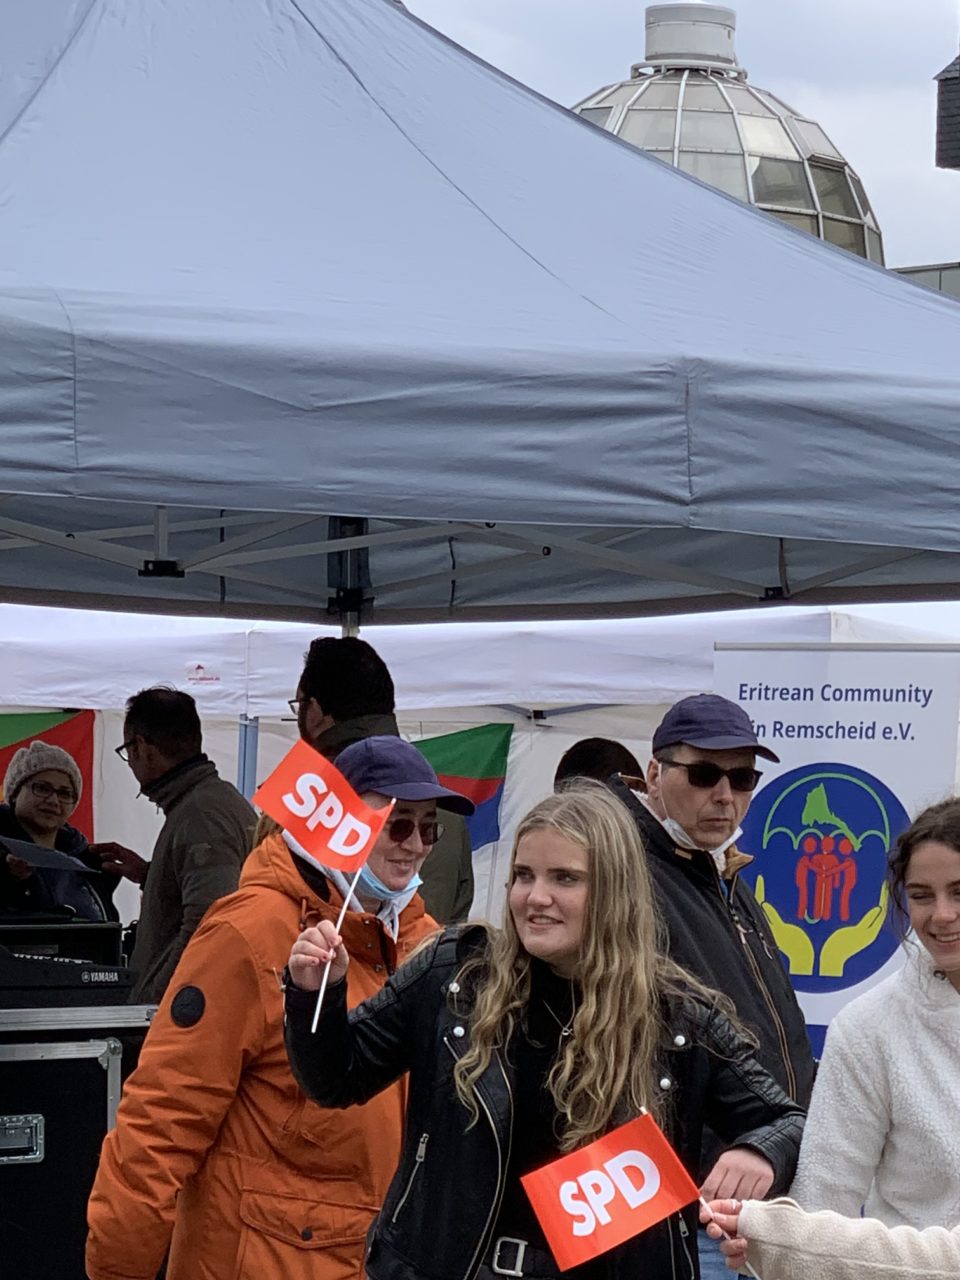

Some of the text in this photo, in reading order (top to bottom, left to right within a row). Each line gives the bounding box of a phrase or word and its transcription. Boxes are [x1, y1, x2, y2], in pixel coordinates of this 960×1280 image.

[738, 683, 933, 708] Eritrean Community
[772, 721, 876, 741] Remscheid
[882, 722, 916, 741] e.V.
[282, 773, 372, 856] SPD
[90, 971, 119, 982] YAMAHA
[559, 1150, 661, 1237] SPD
